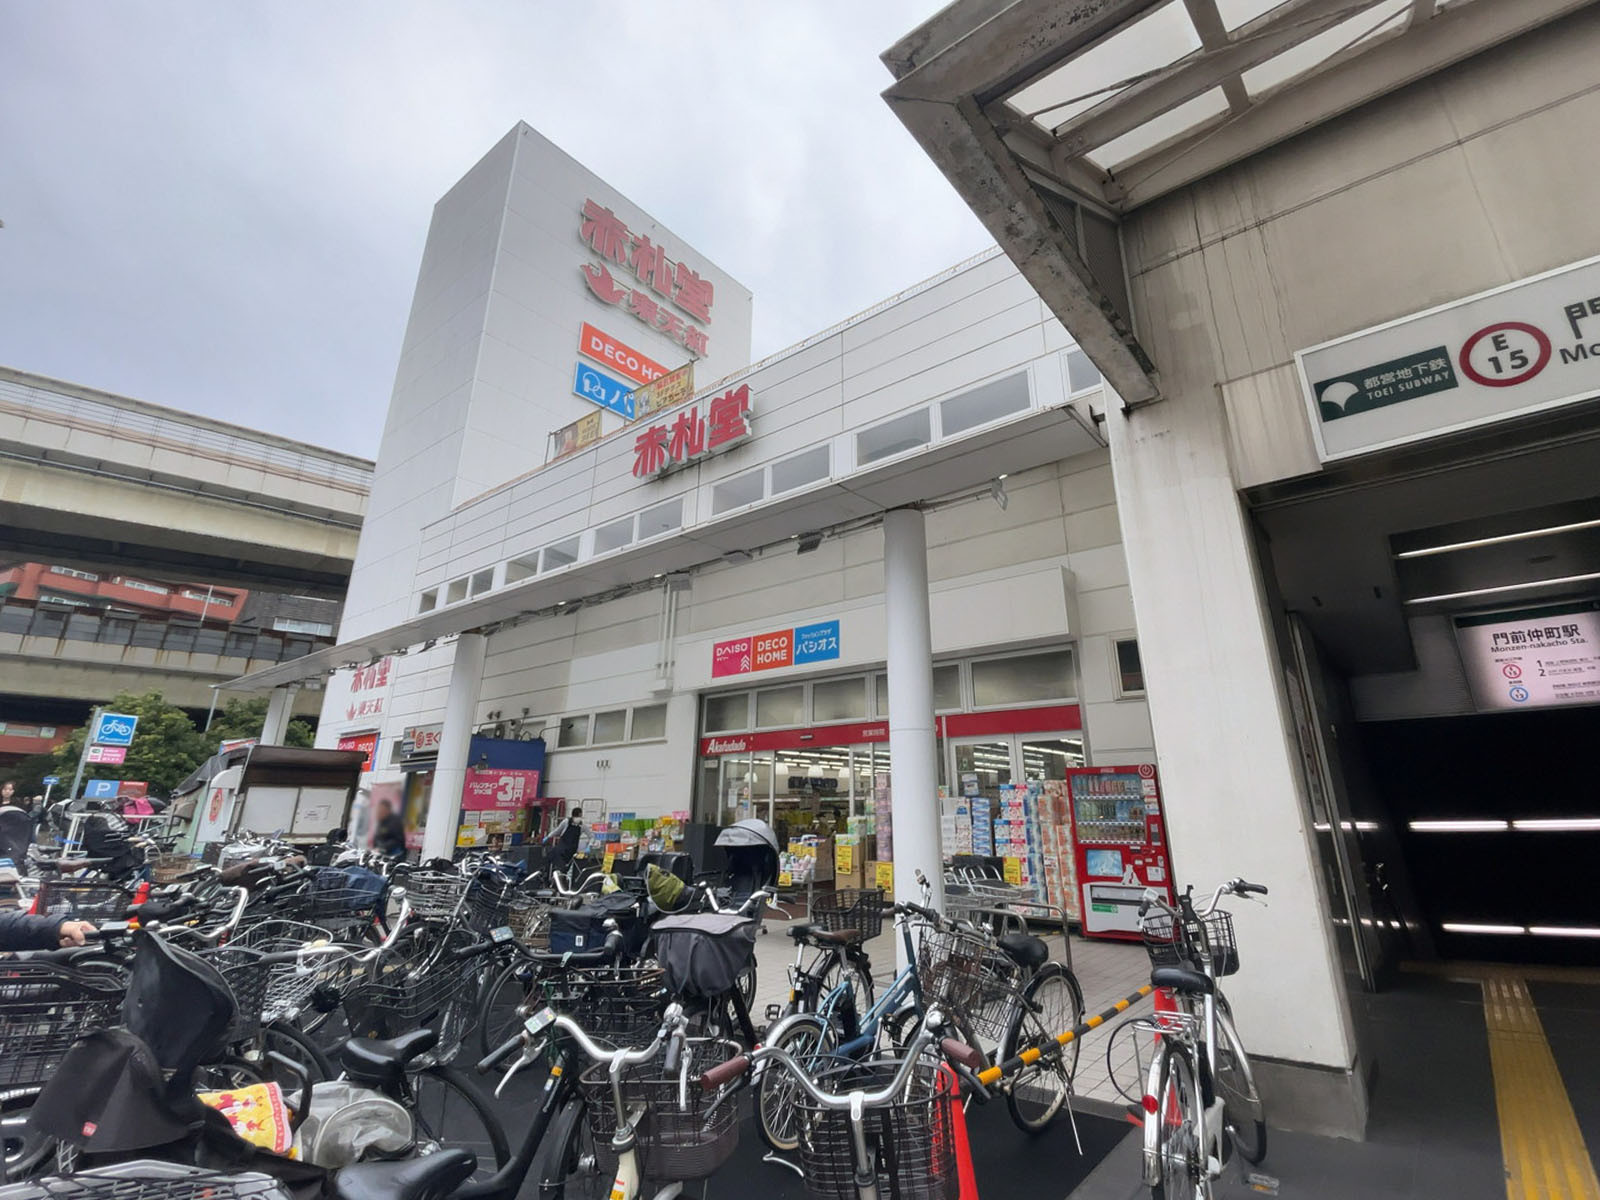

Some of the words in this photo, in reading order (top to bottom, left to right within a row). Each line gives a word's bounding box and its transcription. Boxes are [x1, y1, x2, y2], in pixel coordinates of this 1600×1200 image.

[580, 198, 714, 324] 赤札堂
[629, 289, 709, 358] 東天紅
[1491, 333, 1510, 352] E
[590, 335, 639, 372] DECO
[1488, 349, 1530, 374] 15
[1363, 357, 1448, 390] 都営地下鉄
[1367, 387, 1395, 401] TOEI
[1398, 371, 1451, 393] SUBWAY
[632, 384, 751, 478] 赤札堂
[1492, 623, 1581, 646] 門前仲町駅
[716, 643, 748, 656] DAISO
[757, 637, 788, 652] DECO
[796, 637, 838, 655] パシオス
[1491, 639, 1568, 653] Monzen-nakacho
[1570, 638, 1589, 646] Sta.
[757, 650, 788, 664] HOME
[1538, 669, 1546, 677] 2
[357, 742, 374, 752] DECO
[95, 782, 111, 796] P
